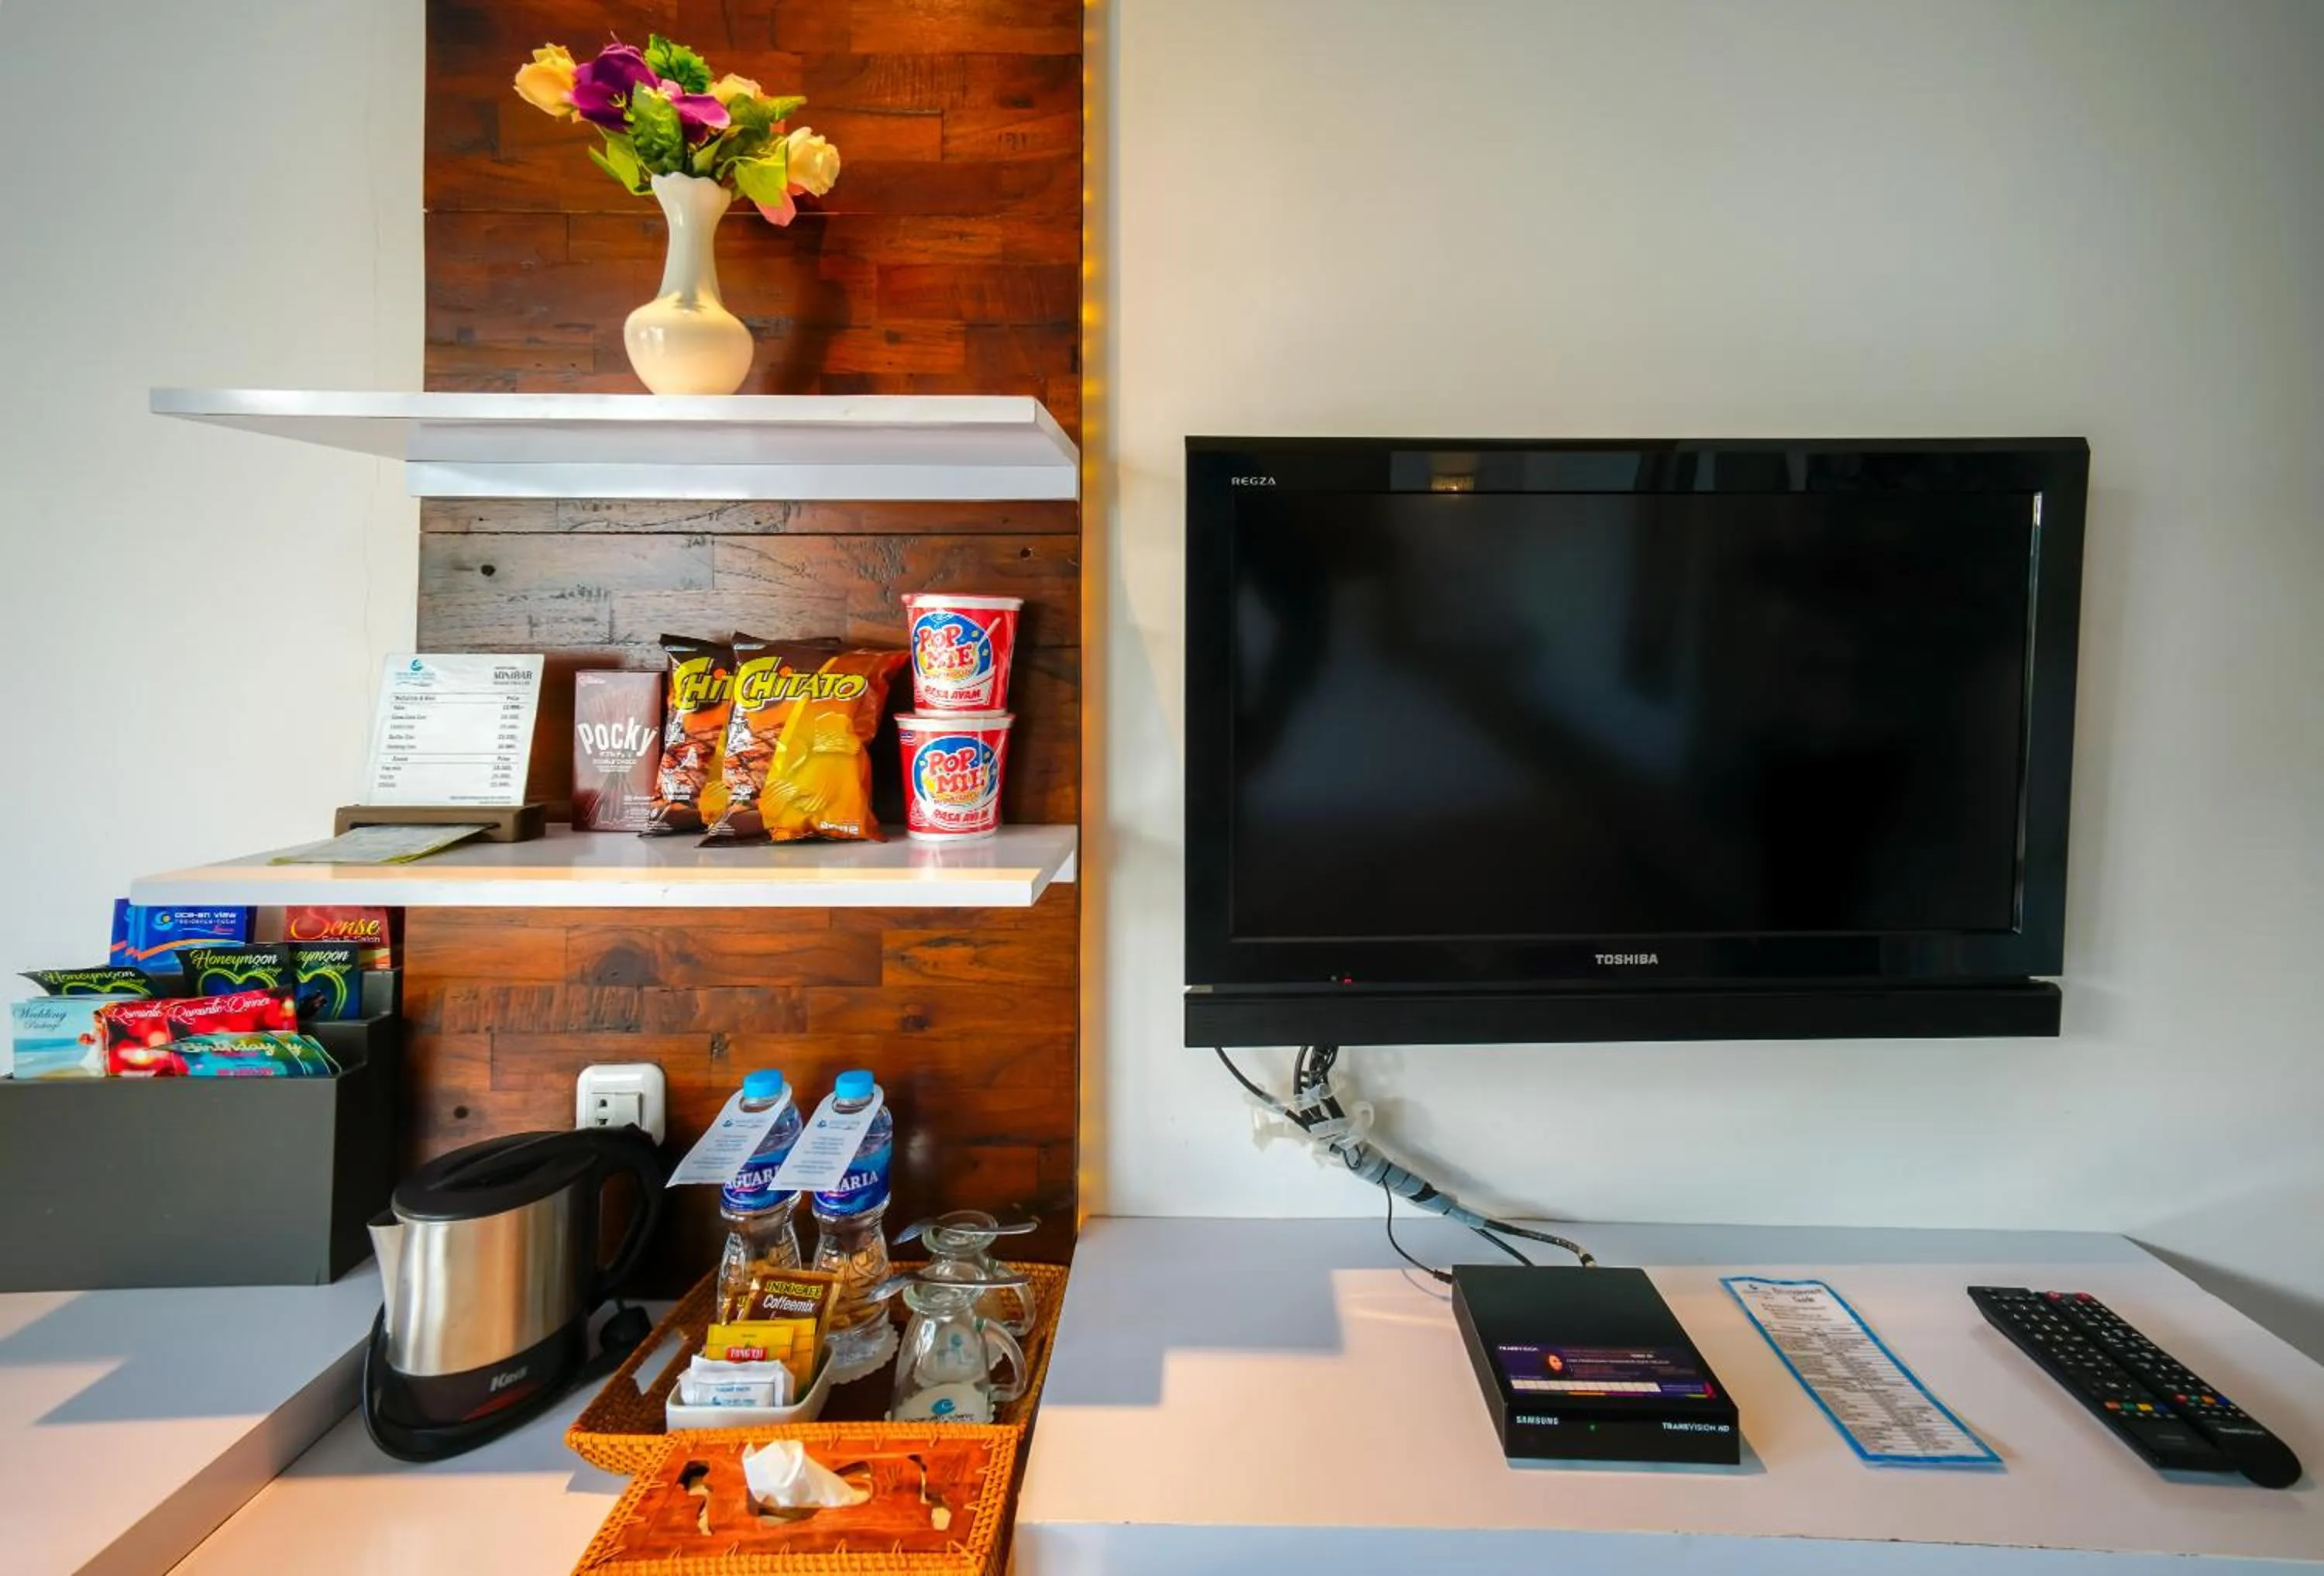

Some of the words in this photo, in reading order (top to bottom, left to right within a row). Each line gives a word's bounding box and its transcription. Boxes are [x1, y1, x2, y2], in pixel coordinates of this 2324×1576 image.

[1231, 477, 1277, 486] REGZA
[917, 625, 963, 652] POP
[927, 748, 976, 777] POP
[290, 907, 380, 941] Sense
[189, 949, 279, 972] Honeymoon
[1595, 954, 1659, 965] TOSHIBA
[13, 1007, 67, 1021] Wedding
[763, 1294, 816, 1313] Coffeemix
[1516, 1416, 1559, 1425] SAMSUNG
